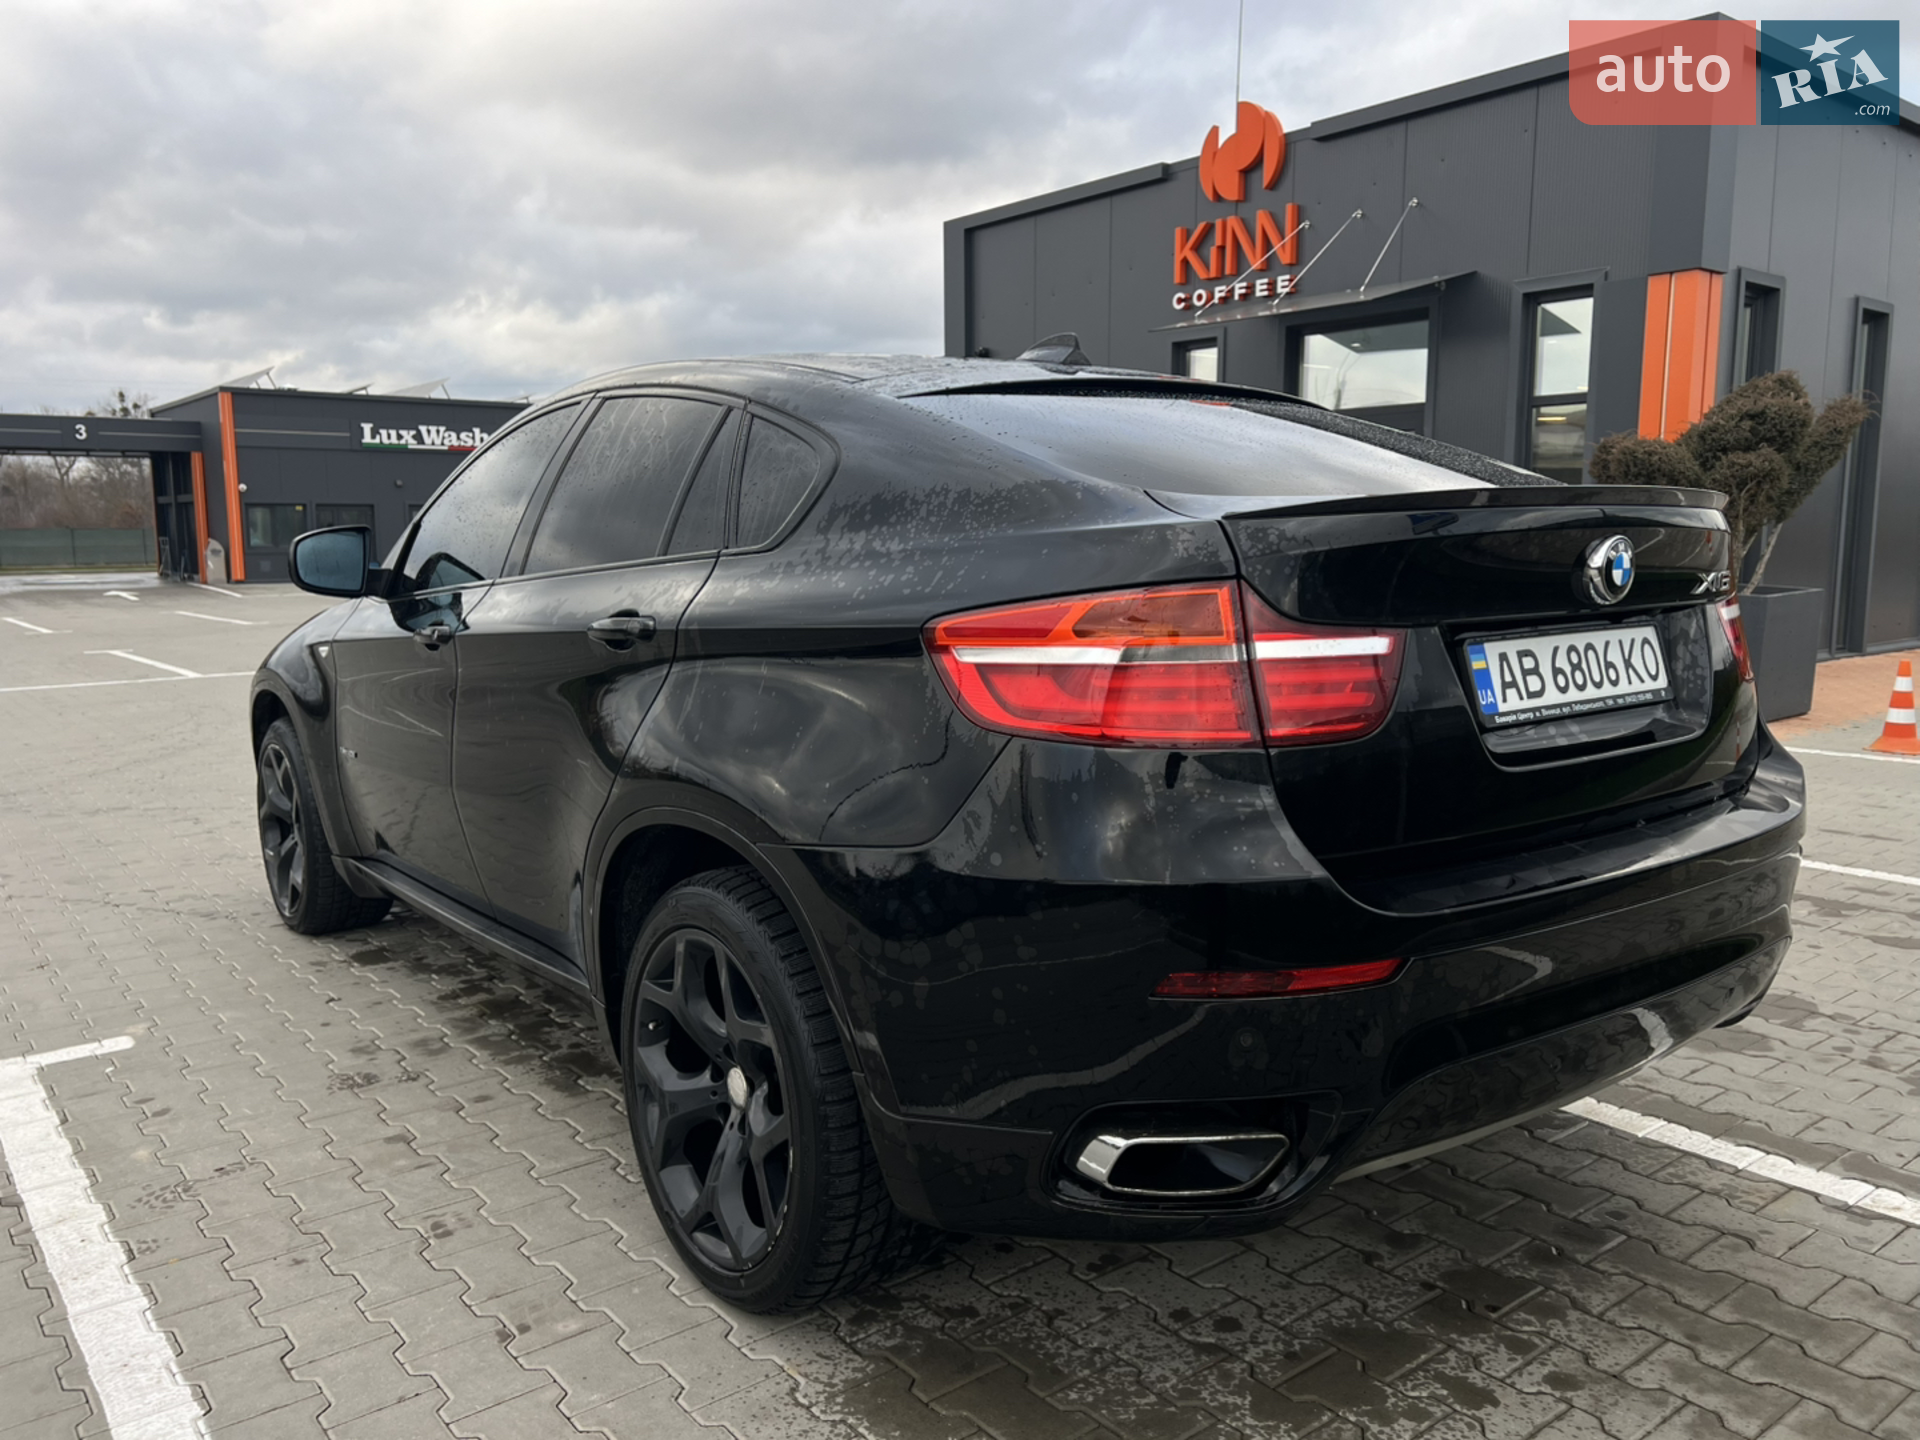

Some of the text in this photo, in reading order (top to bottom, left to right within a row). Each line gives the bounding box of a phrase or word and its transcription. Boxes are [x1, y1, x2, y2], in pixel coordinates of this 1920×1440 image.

[1172, 274, 1294, 310] COFFEE
[74, 424, 87, 440] 3
[360, 422, 490, 447] Lux Wash
[1690, 570, 1731, 595] X6
[1498, 636, 1660, 704] AB 6806 KO
[1477, 688, 1496, 705] UA
